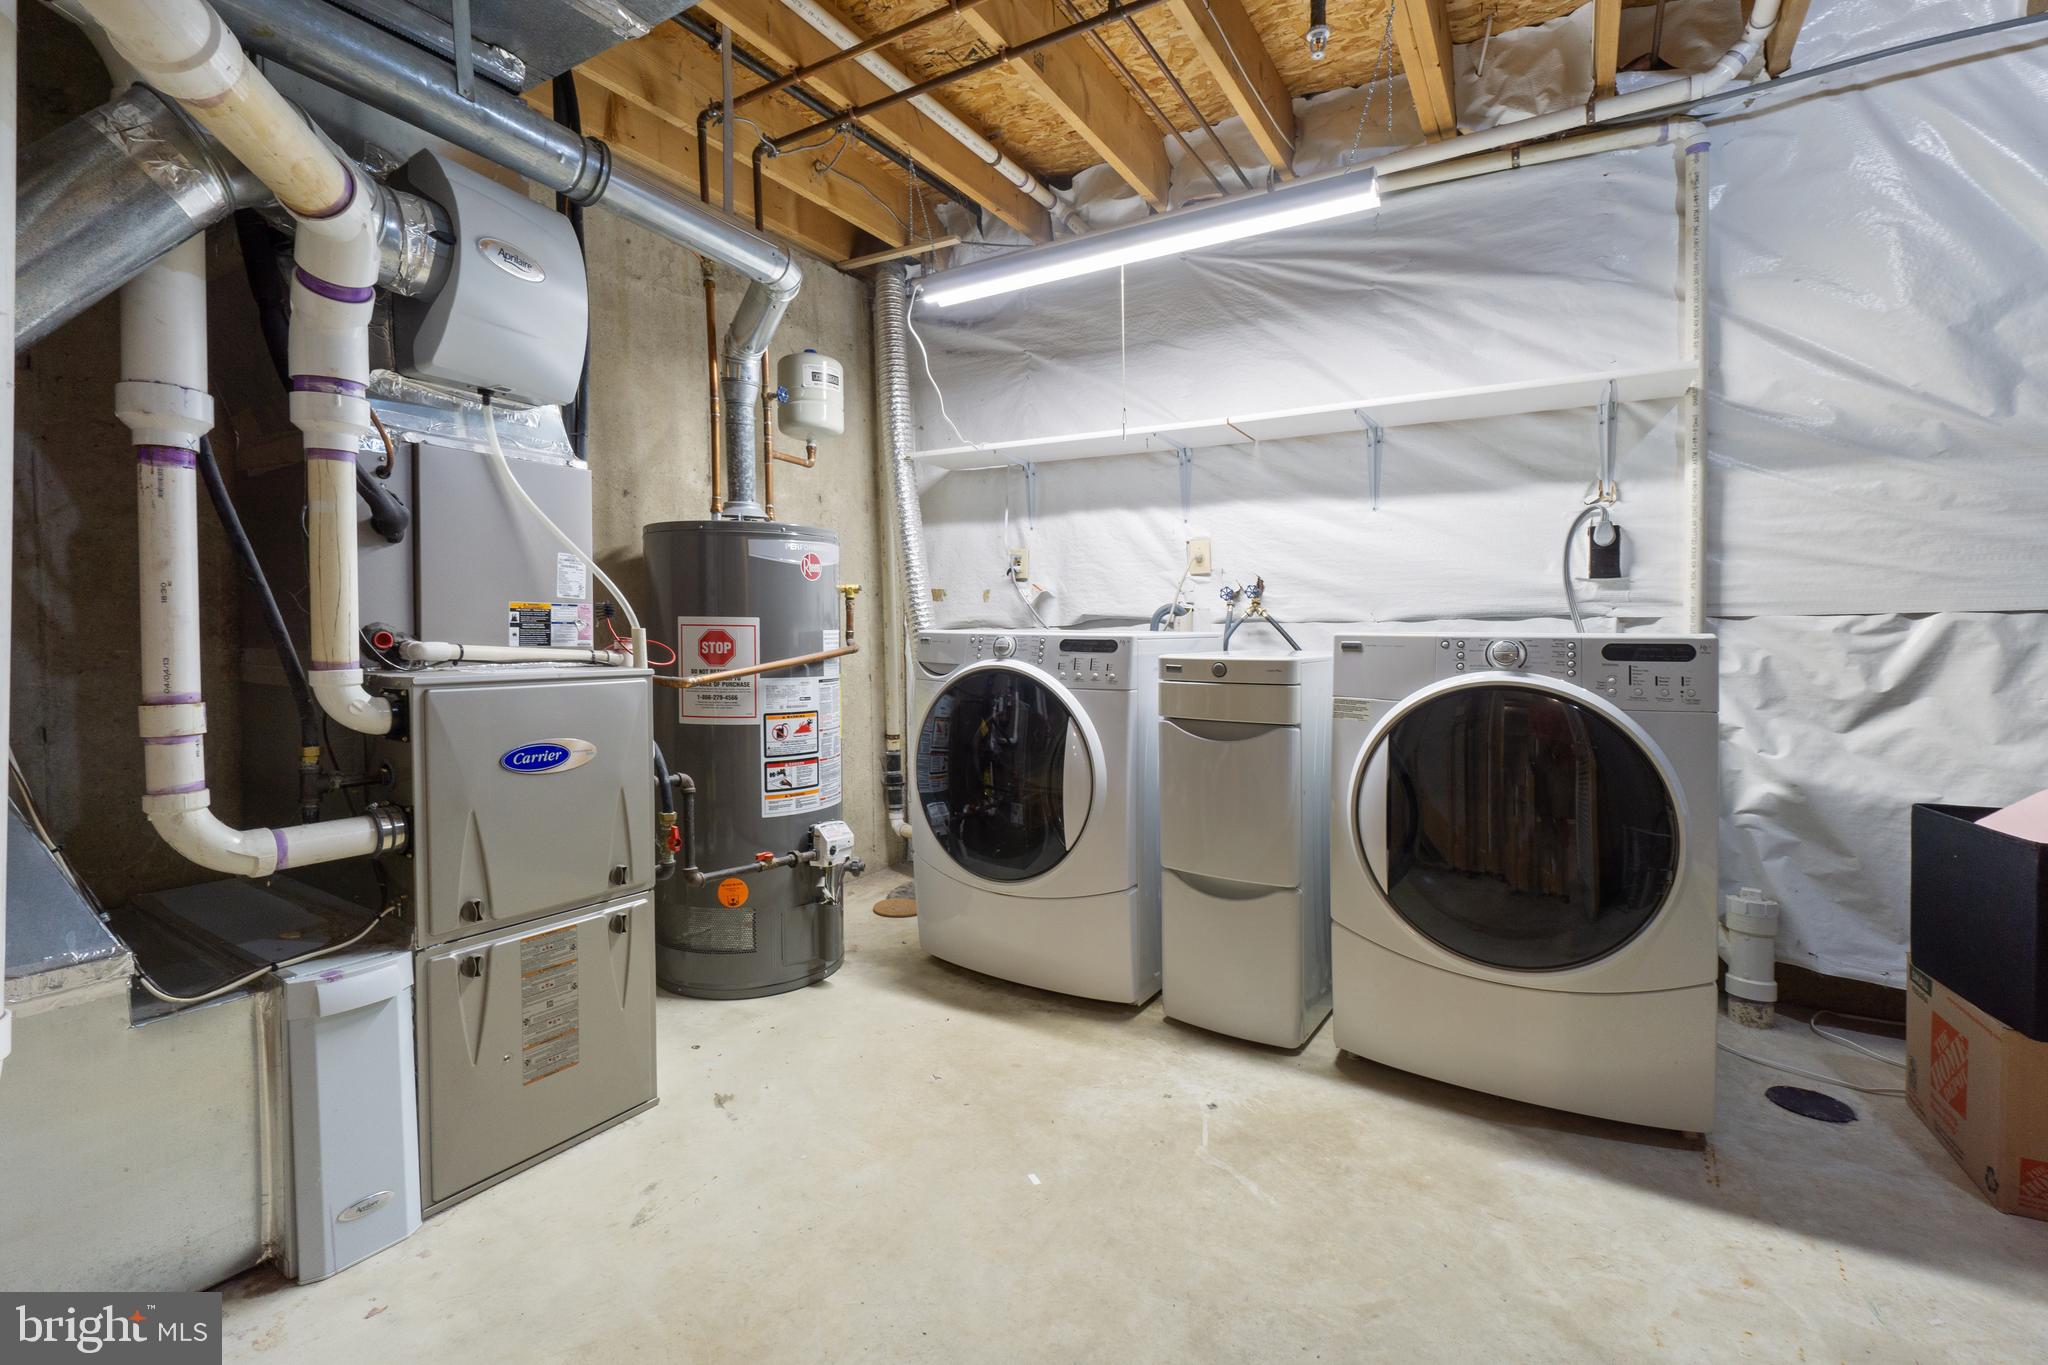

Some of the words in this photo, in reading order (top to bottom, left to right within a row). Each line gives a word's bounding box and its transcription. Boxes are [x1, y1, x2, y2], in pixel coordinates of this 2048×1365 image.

[701, 641, 732, 654] STOP
[163, 657, 171, 694] 04/04/13
[513, 750, 563, 765] Carrier
